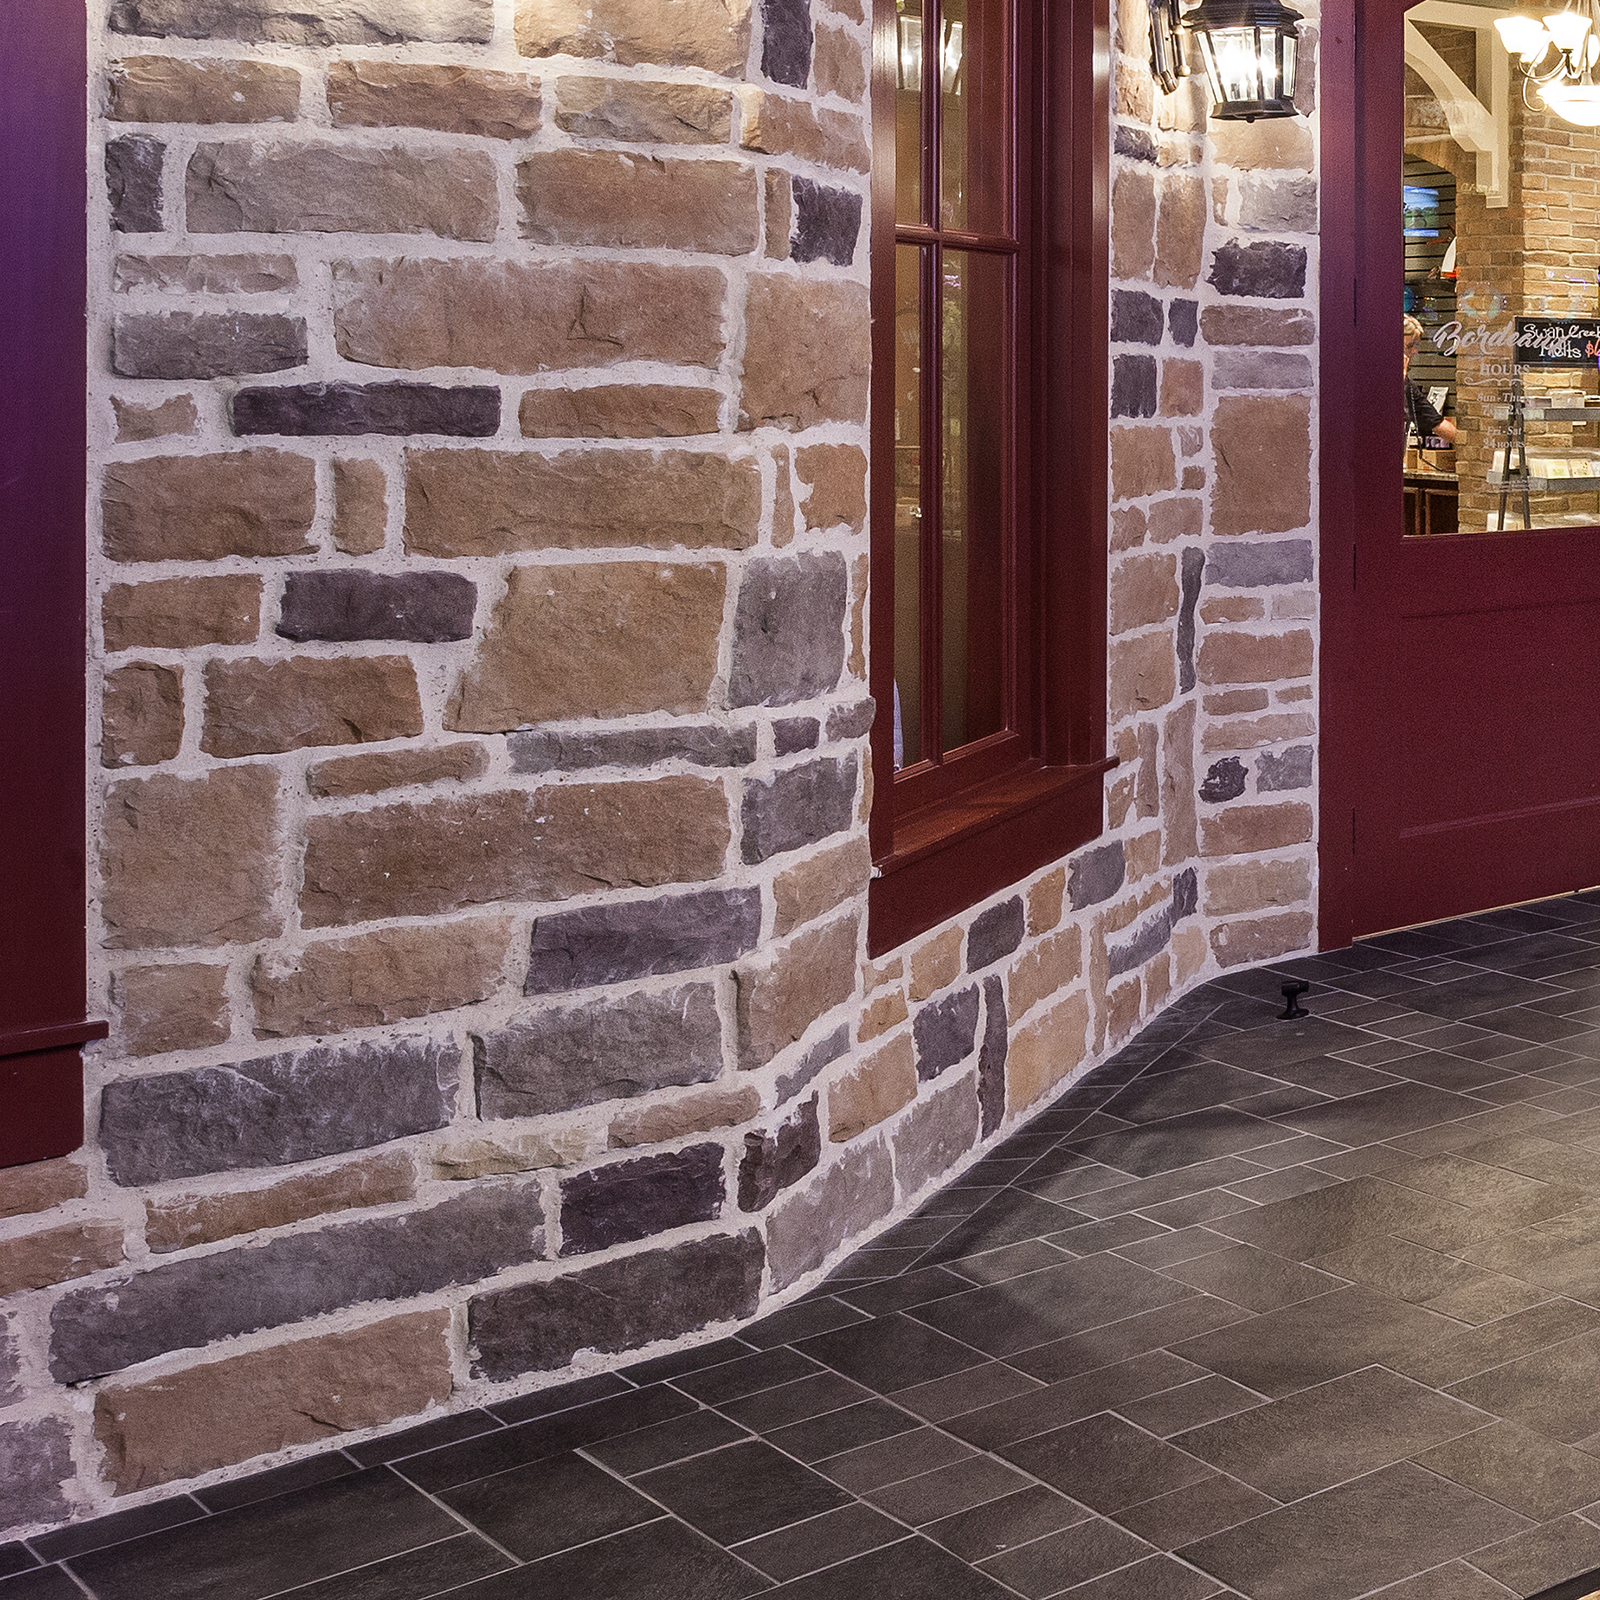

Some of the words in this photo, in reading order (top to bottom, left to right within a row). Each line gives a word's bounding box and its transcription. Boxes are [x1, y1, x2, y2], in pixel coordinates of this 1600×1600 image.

[1433, 321, 1570, 357] Bordeaux
[1523, 323, 1565, 339] Swan
[1480, 363, 1531, 377] HOURS
